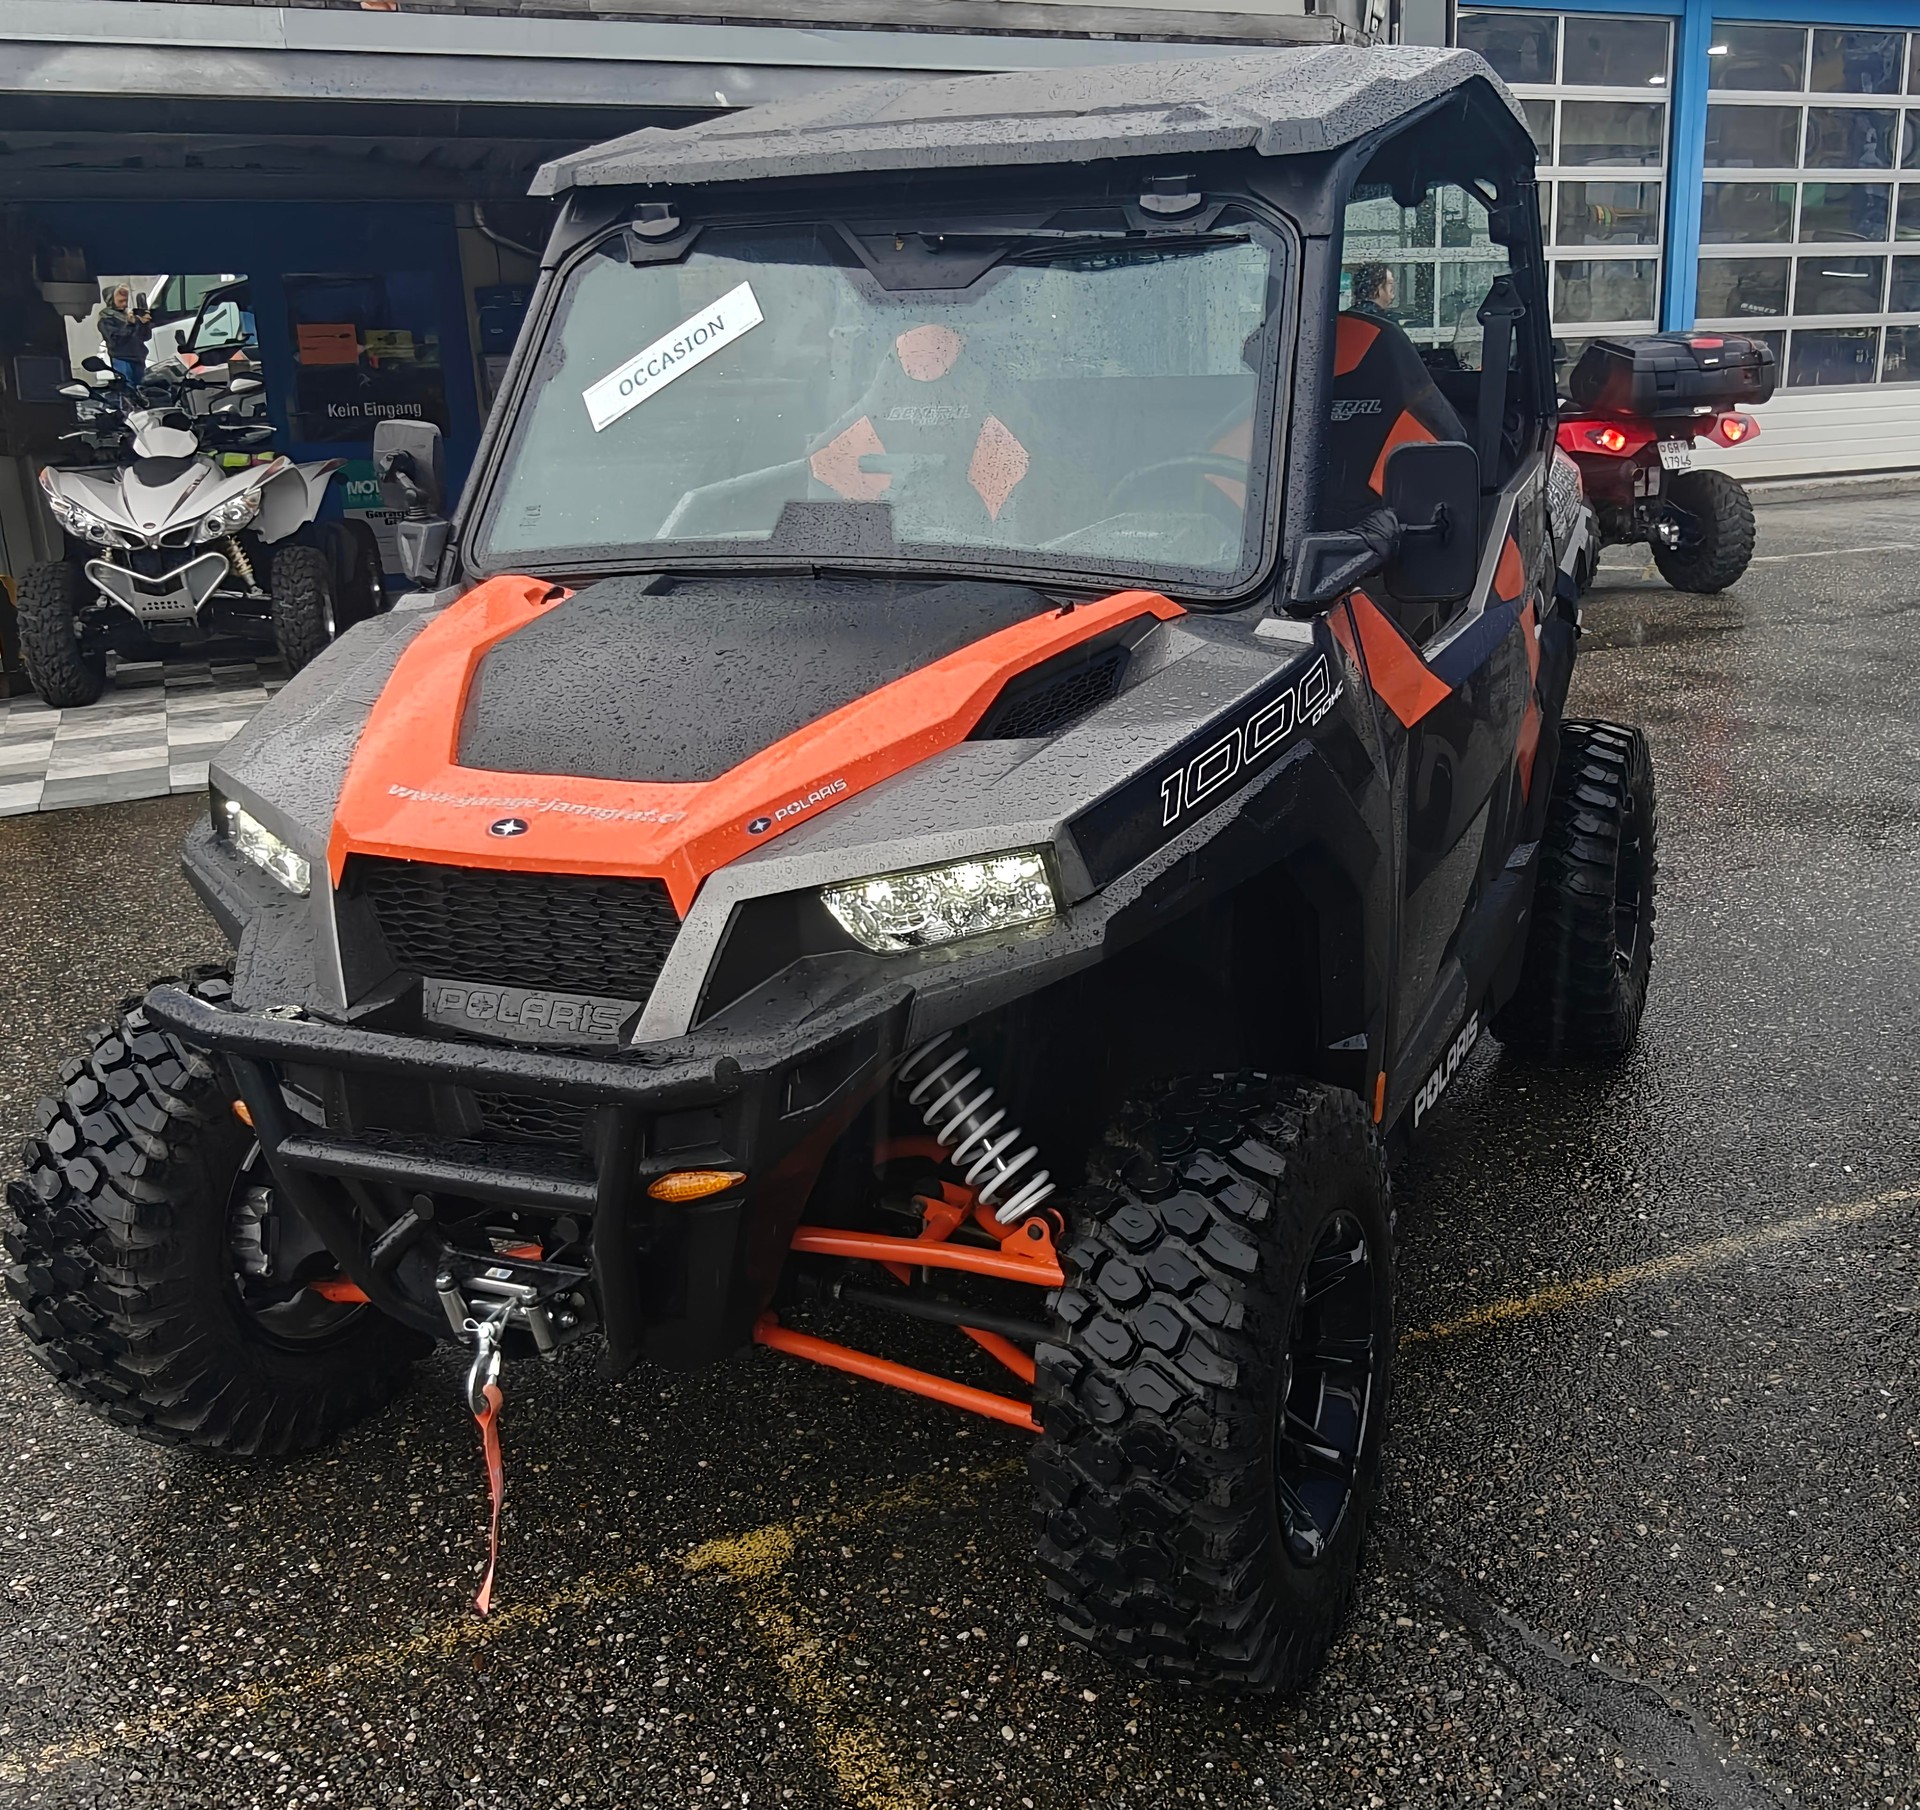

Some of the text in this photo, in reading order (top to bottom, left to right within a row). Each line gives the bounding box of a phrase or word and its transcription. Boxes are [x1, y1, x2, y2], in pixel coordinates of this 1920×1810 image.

[618, 314, 726, 397] OCCASION
[328, 402, 422, 418] Kein Eingang
[1666, 442, 1681, 454] GR
[1312, 679, 1344, 727] DOHC
[1160, 653, 1331, 827] 1000
[774, 777, 848, 822] POLARIS
[434, 986, 623, 1036] POLARIS
[1413, 1008, 1479, 1129] POLARIS
